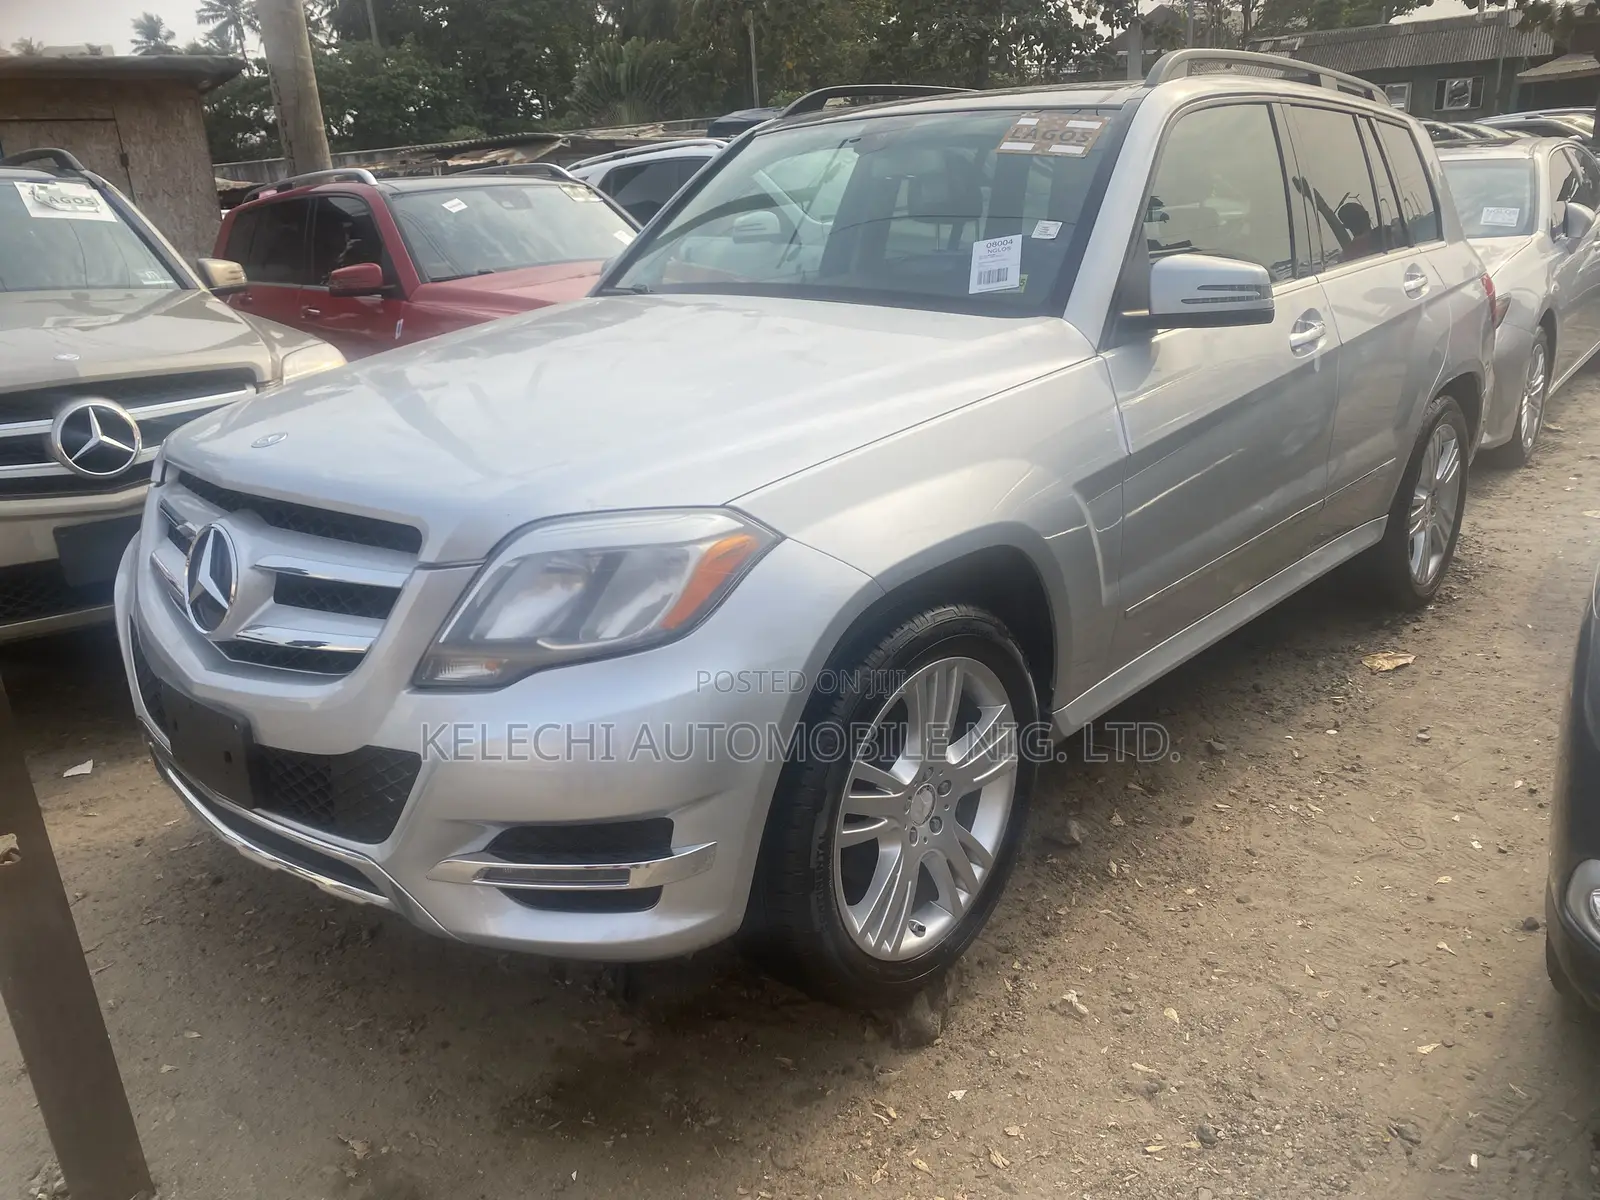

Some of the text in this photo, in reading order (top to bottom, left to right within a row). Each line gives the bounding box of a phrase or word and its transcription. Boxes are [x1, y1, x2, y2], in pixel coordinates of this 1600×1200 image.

[1010, 127, 1093, 143] LAGOS
[46, 195, 95, 206] AGOS
[986, 238, 1013, 249] 08004
[987, 246, 1012, 254] NGLOS
